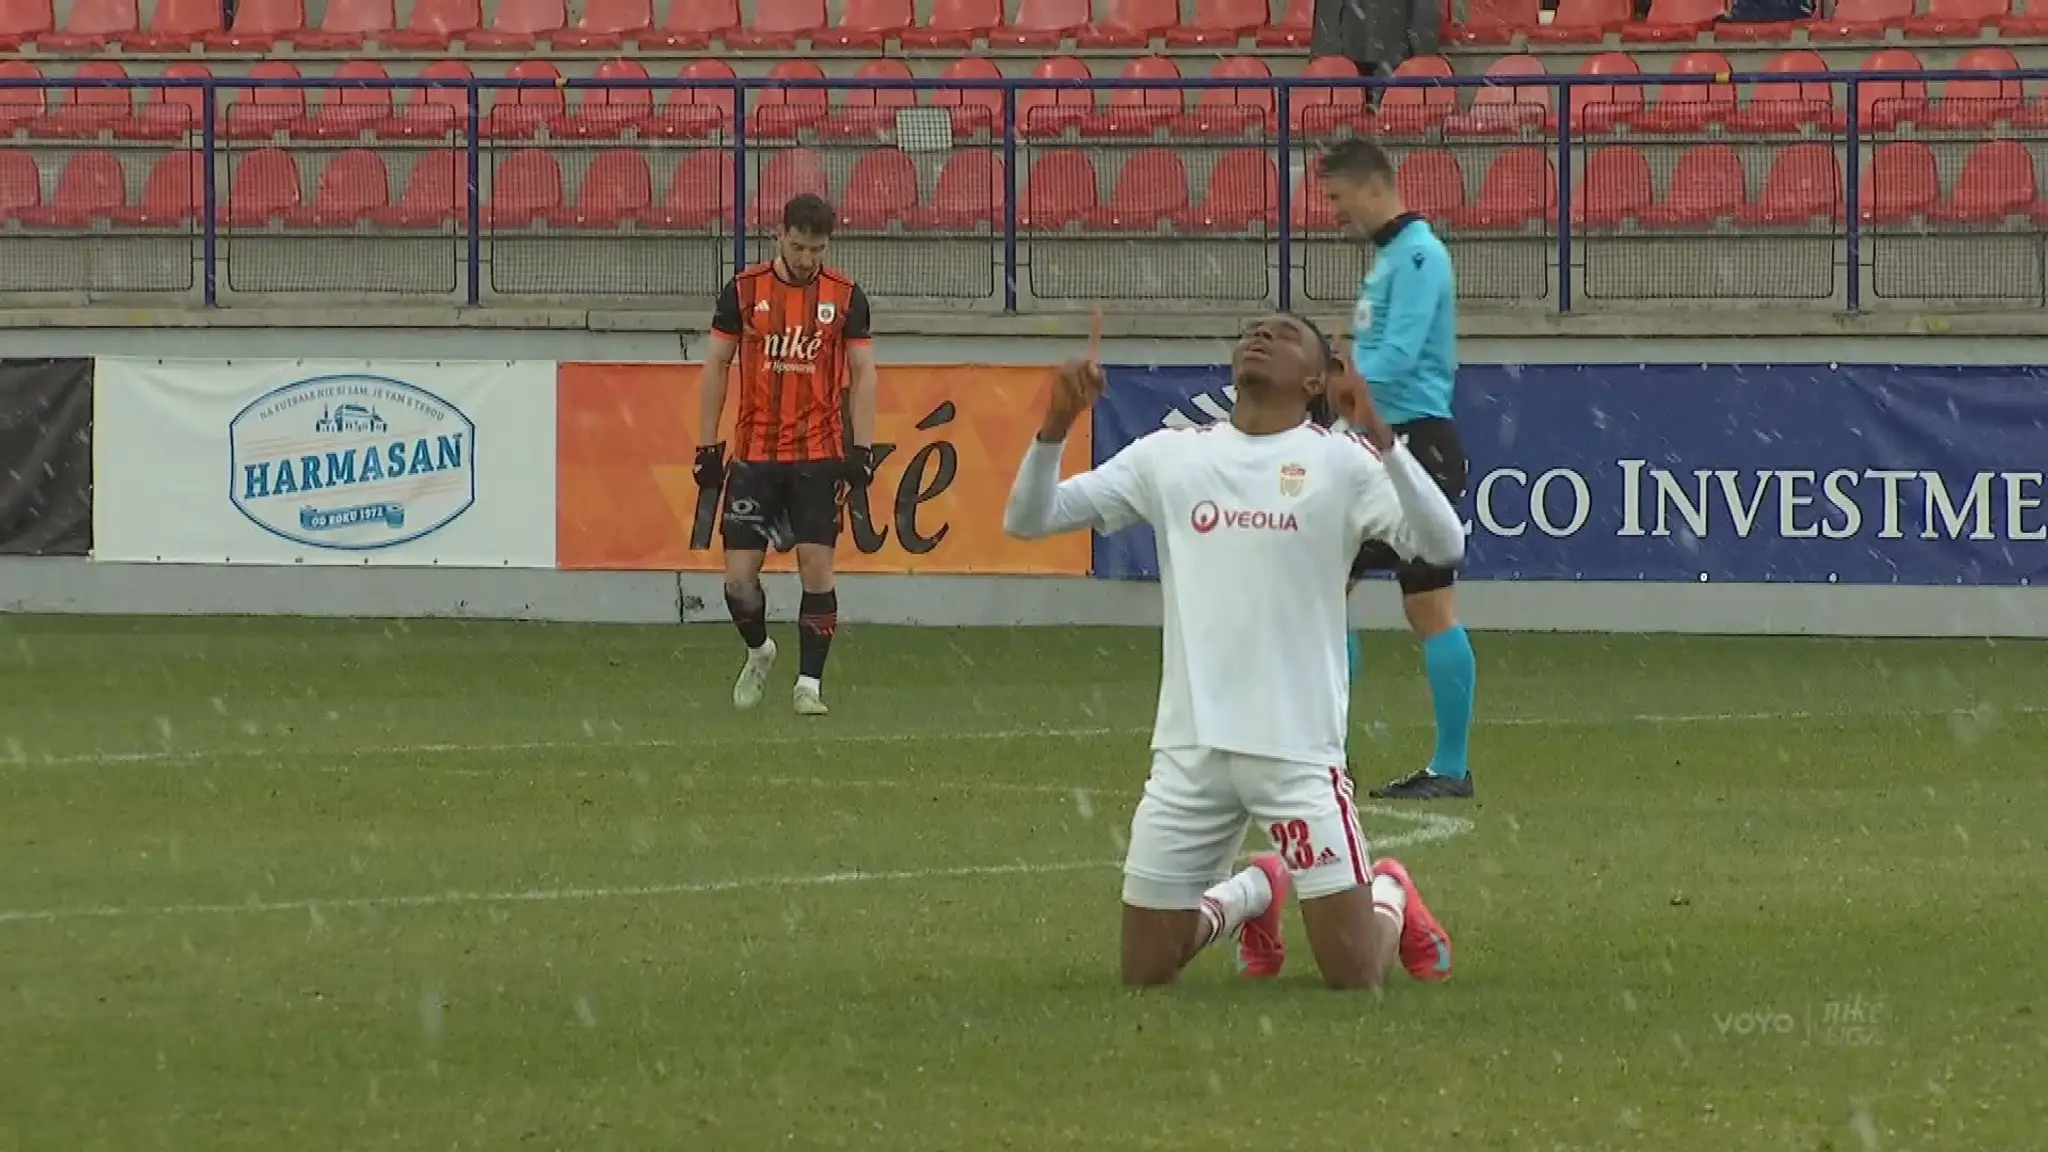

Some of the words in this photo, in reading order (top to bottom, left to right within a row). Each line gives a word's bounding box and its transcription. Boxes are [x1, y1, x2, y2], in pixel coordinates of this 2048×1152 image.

[763, 325, 822, 361] niké
[244, 433, 462, 499] HARMASAN
[1224, 510, 1299, 532] VEOLIA
[1461, 459, 1591, 538] CO
[1270, 818, 1315, 870] 23
